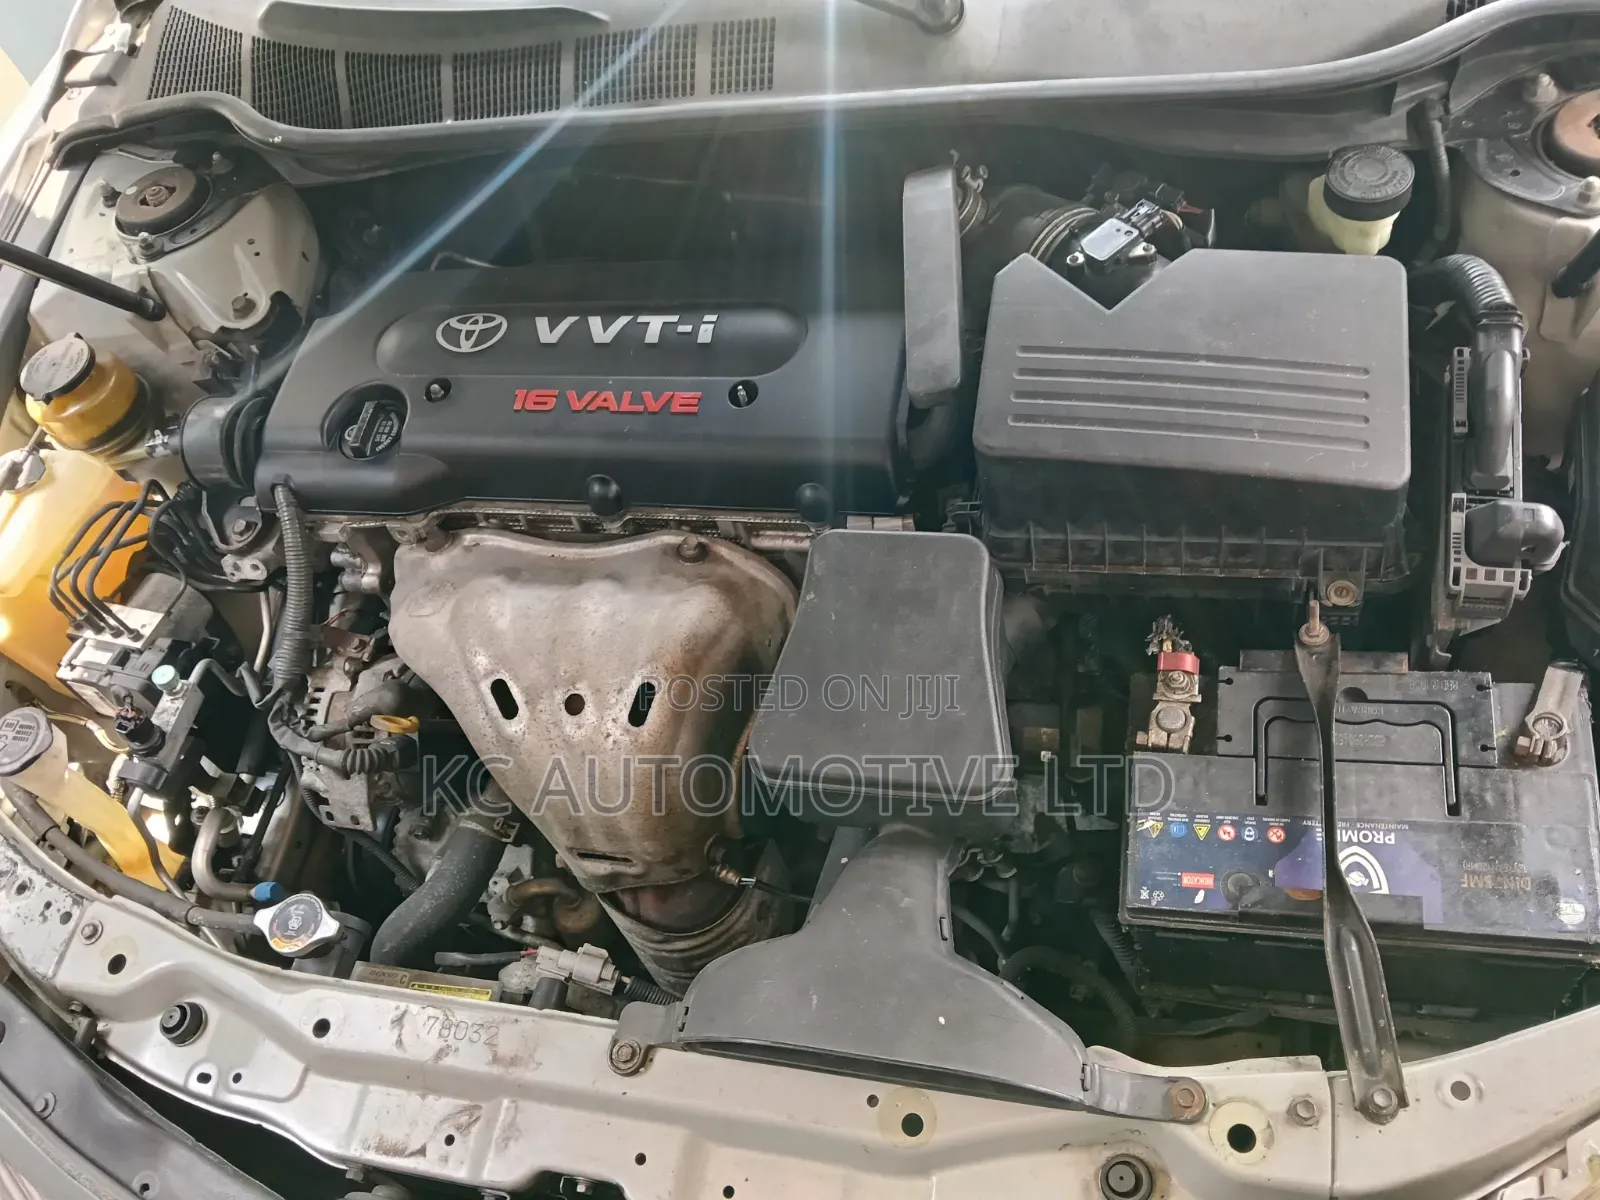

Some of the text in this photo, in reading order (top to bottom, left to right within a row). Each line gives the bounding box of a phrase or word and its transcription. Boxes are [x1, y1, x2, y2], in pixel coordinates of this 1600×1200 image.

[534, 314, 719, 346] VVT-i
[512, 388, 703, 414] 16 VALVE
[1315, 828, 1396, 845] PROMIE
[1356, 821, 1409, 831] MAINTENANCE
[1182, 875, 1213, 886] INDICATOR
[423, 1015, 500, 1047] 78032
